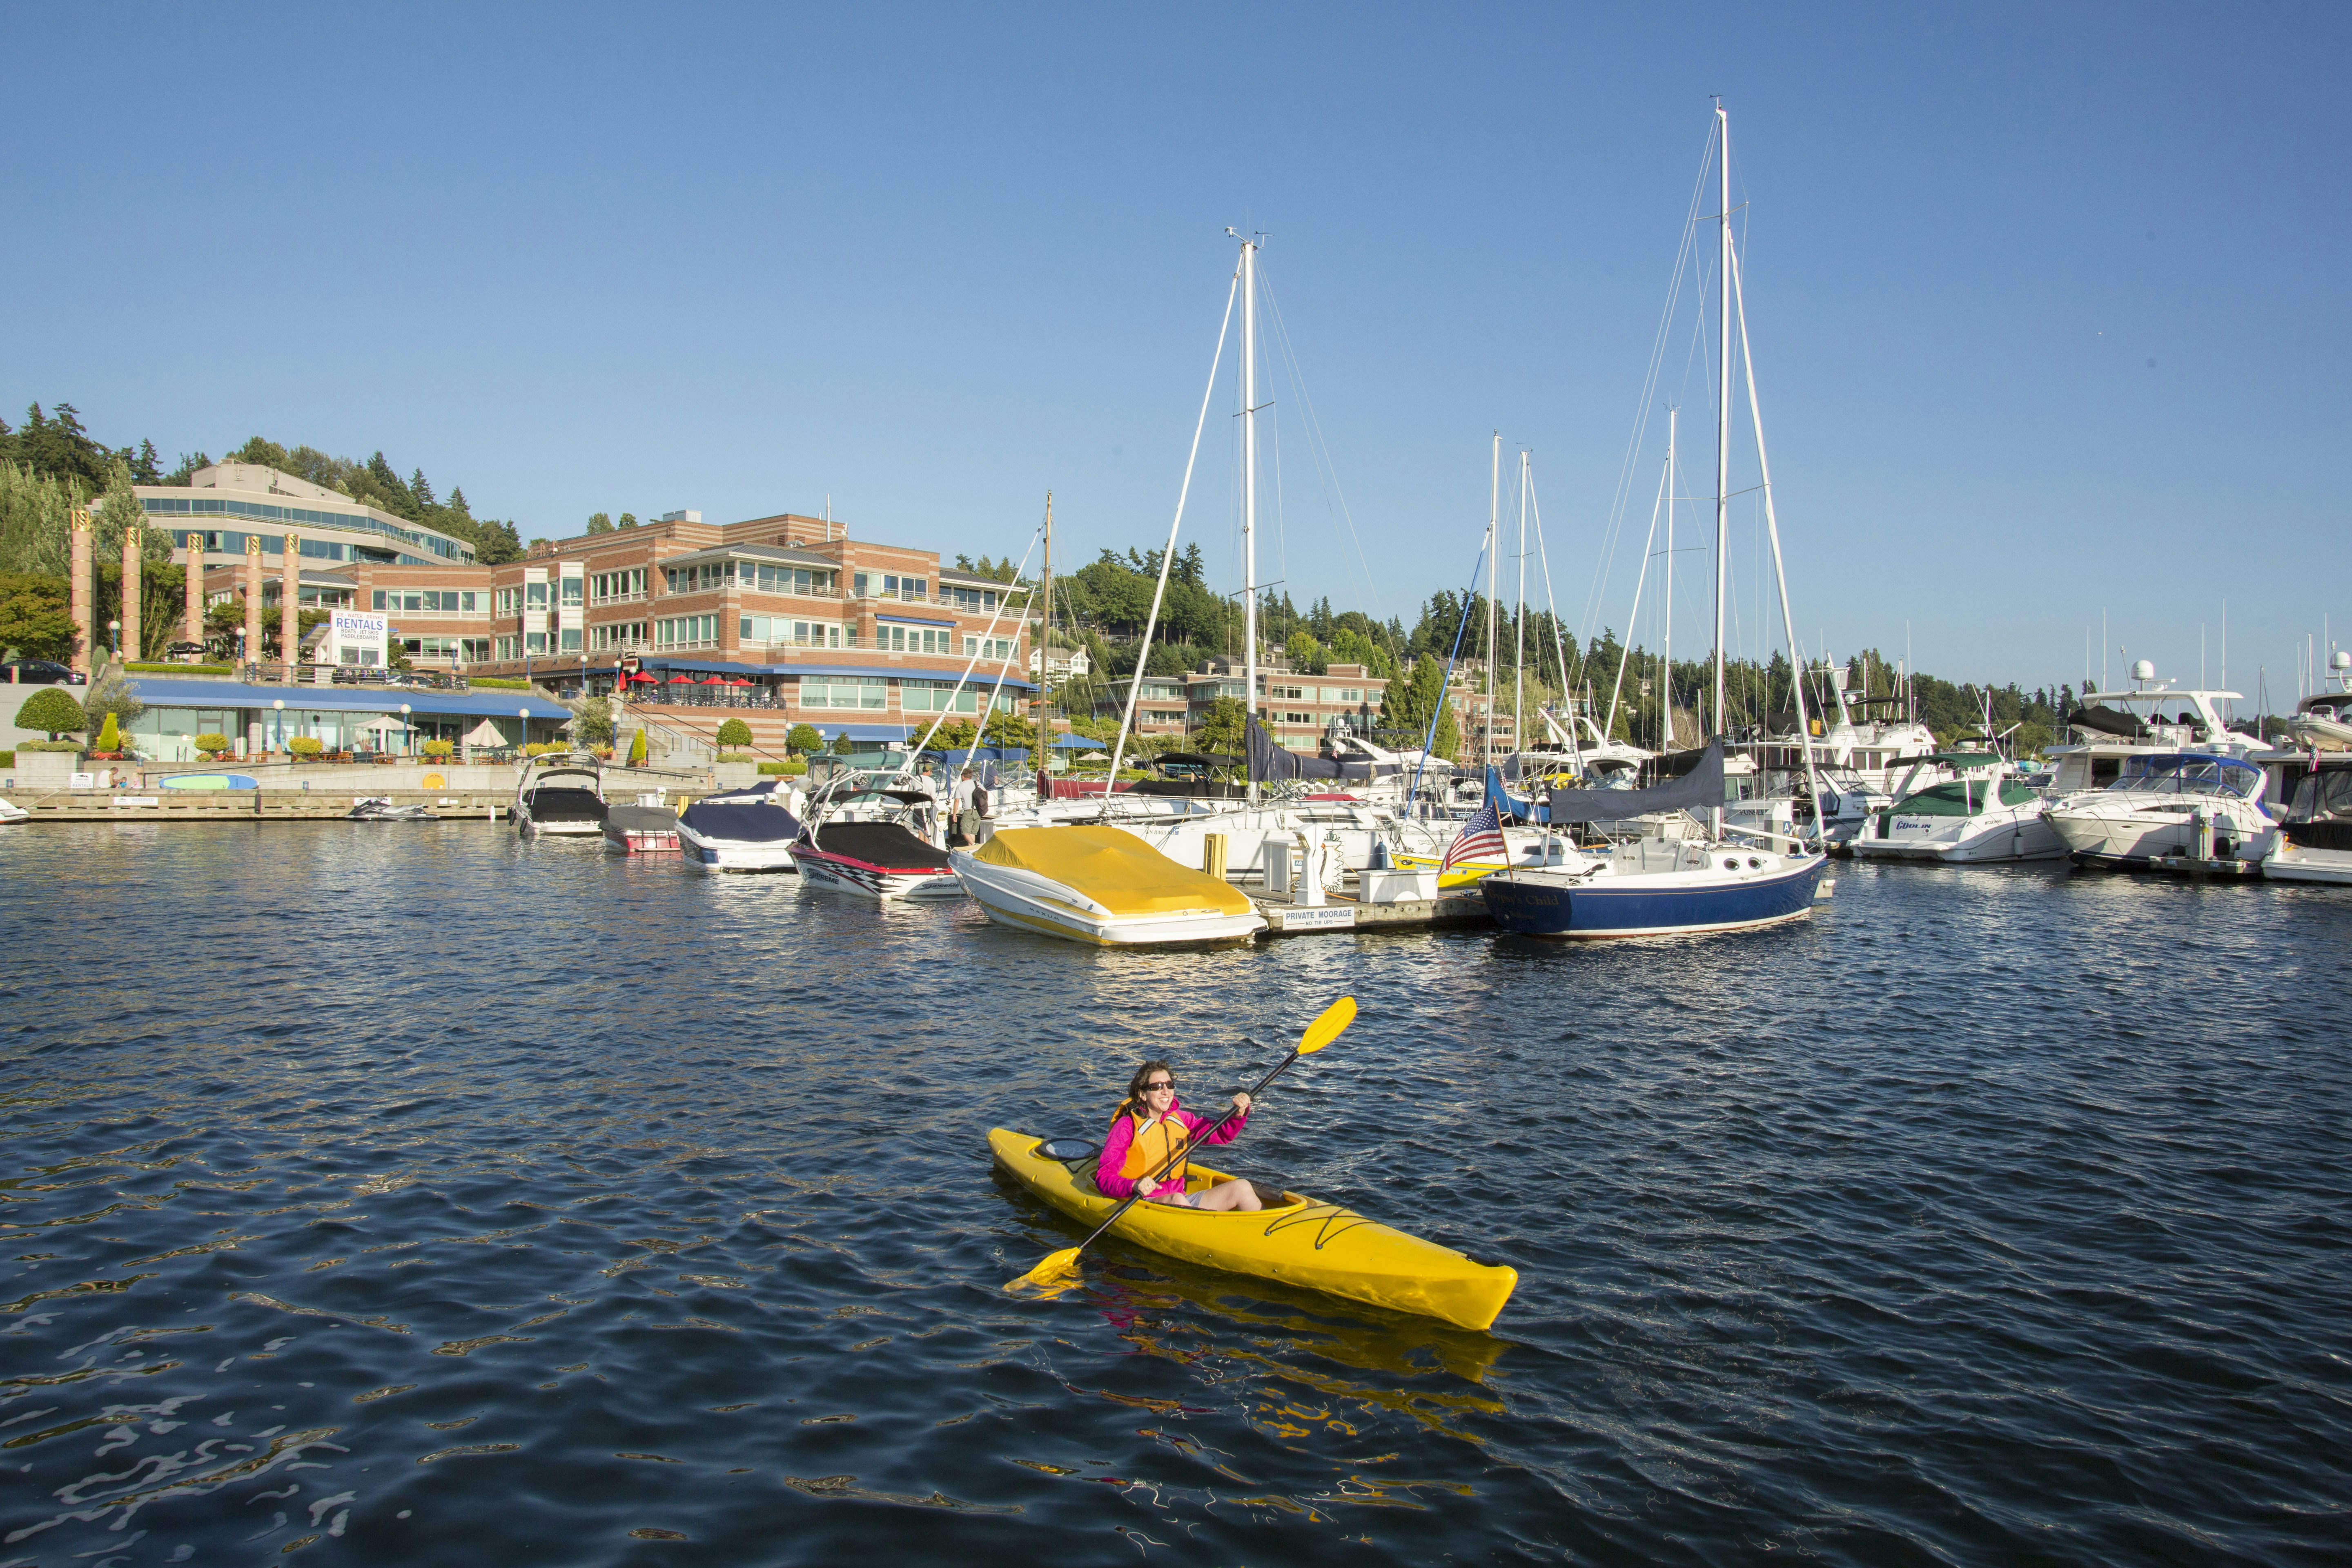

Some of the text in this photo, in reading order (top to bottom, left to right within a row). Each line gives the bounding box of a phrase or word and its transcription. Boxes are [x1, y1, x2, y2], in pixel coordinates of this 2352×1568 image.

[336, 618, 383, 630] RENTALS
[1784, 822, 1789, 831] A
[807, 868, 840, 885] SUPREME
[1525, 895, 1560, 905] Child
[1029, 907, 1060, 921] MAXUM
[1286, 910, 1352, 920] PRIVATE MOORAGE
